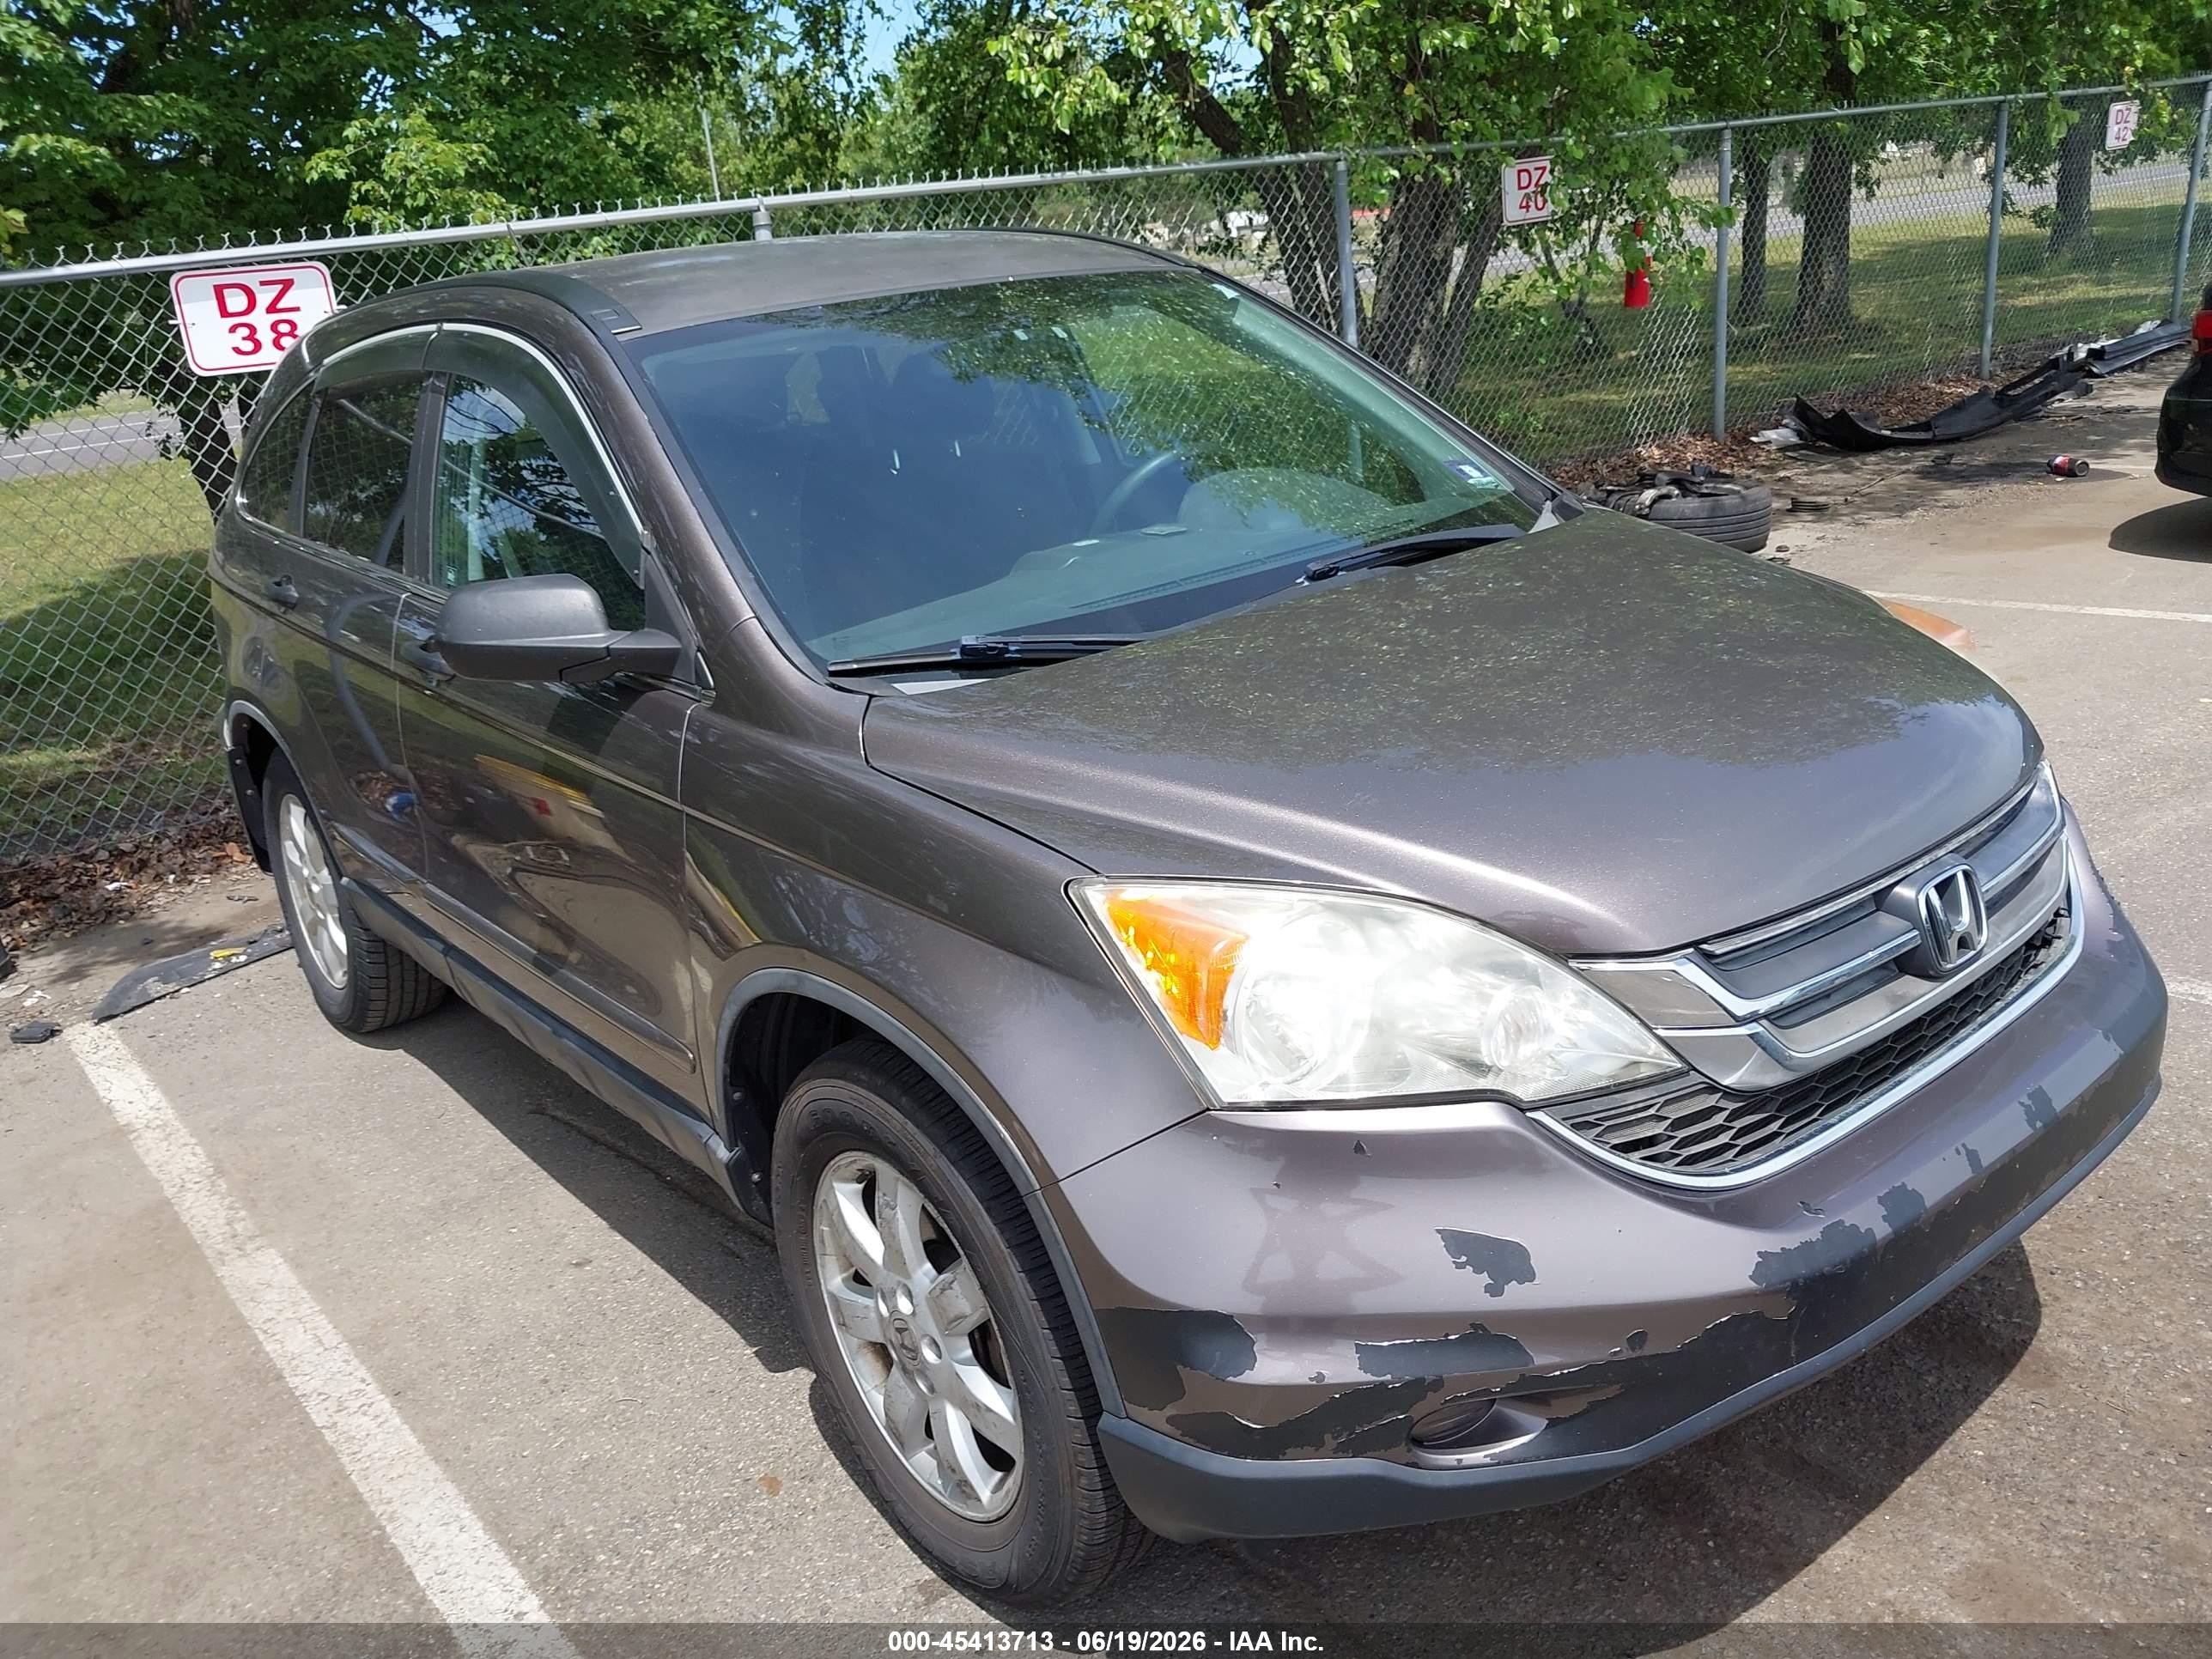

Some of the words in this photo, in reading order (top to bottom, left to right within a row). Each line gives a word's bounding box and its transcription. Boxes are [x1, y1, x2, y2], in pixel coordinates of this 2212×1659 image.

[2115, 107, 2132, 125] DZ
[2114, 126, 2130, 143] 42
[1516, 166, 1547, 191] DZ
[1518, 191, 1548, 214] 40
[212, 277, 301, 319] DZ
[228, 319, 300, 356] 38
